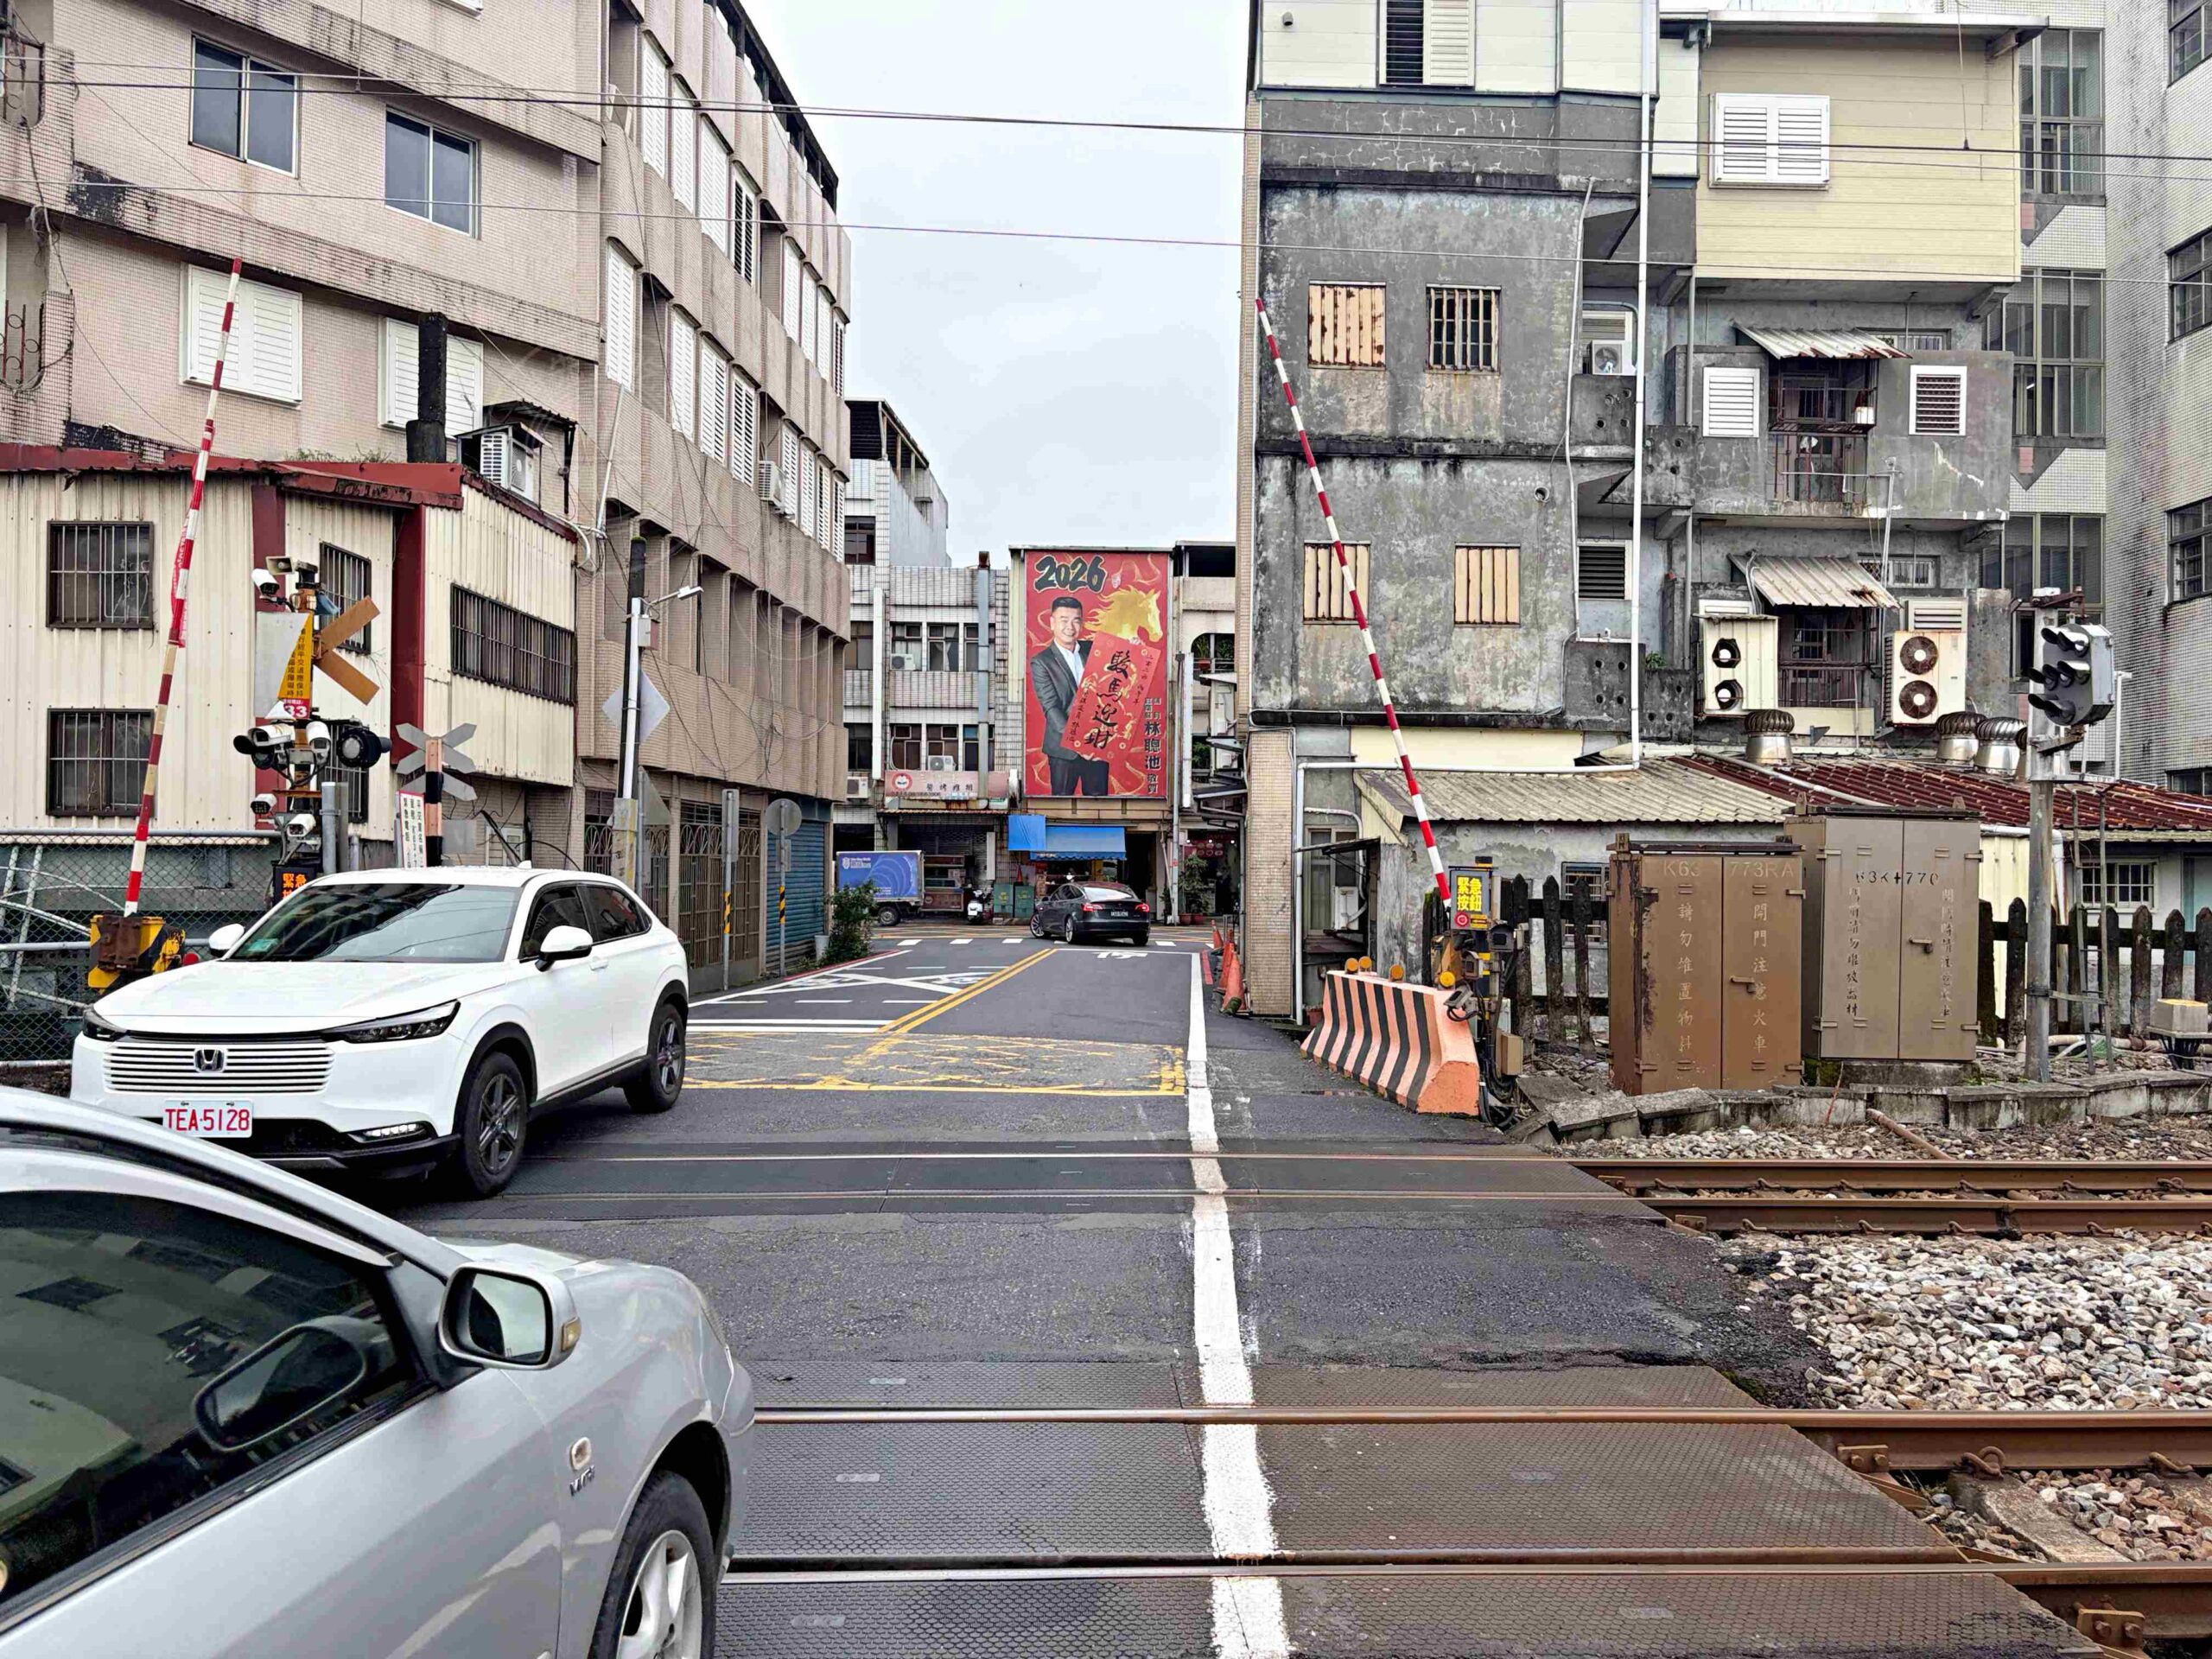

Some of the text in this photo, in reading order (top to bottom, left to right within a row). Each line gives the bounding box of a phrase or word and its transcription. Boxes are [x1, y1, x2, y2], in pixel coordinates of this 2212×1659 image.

[1033, 555, 1108, 594] 2026
[1457, 877, 1482, 894] 緊急
[1457, 894, 1482, 912] 按鈕
[1752, 903, 1768, 1053] 開門注意火車
